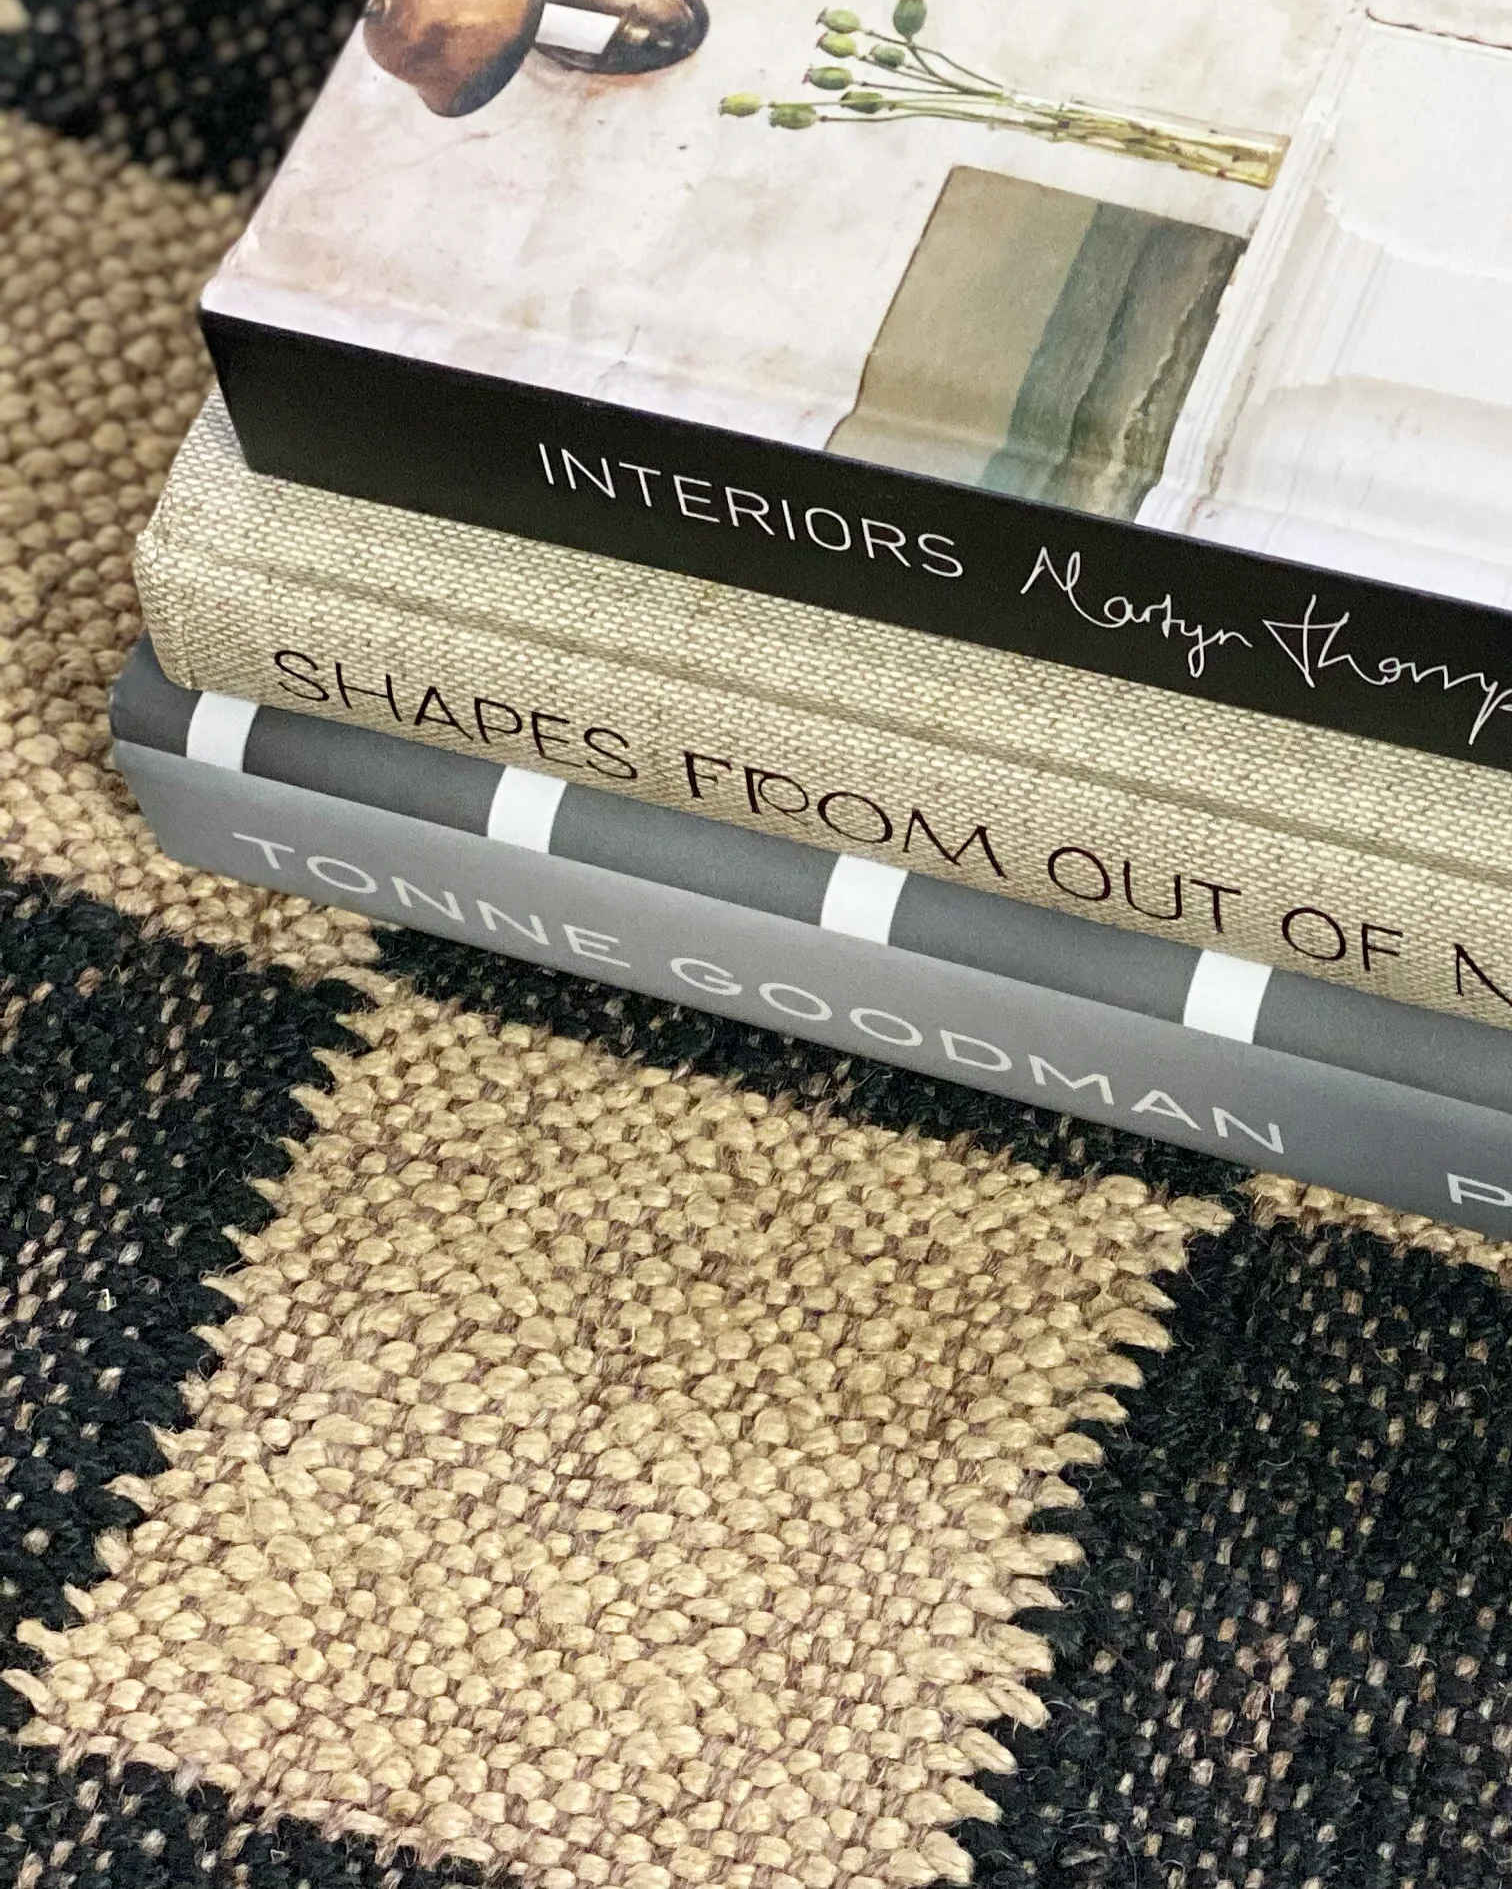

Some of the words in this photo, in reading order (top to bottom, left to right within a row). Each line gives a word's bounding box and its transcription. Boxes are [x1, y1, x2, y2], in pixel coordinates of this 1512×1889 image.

[538, 443, 964, 578] INTERIORS
[274, 649, 638, 780] SHAPES
[683, 750, 1007, 879] FROM
[1047, 846, 1241, 933] OUT
[1281, 907, 1403, 971] OF
[232, 832, 631, 969] TONNE
[670, 957, 1284, 1155] GOODMAN
